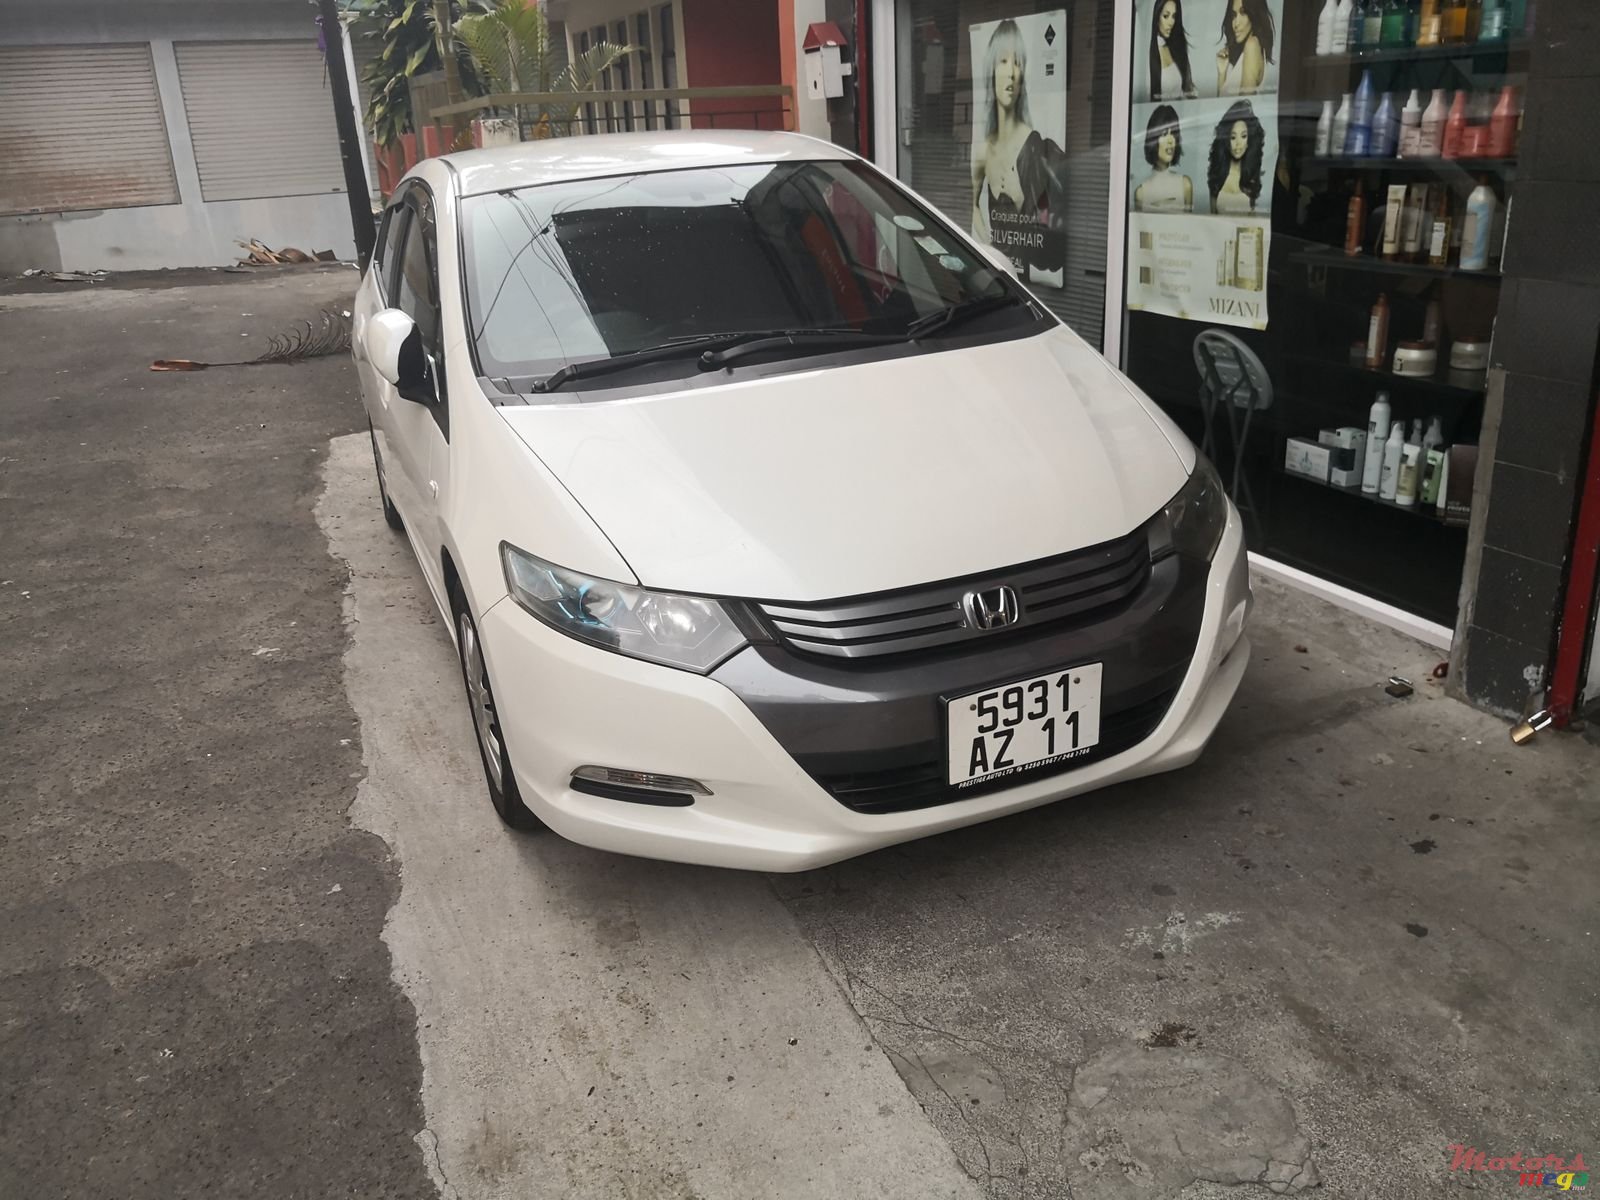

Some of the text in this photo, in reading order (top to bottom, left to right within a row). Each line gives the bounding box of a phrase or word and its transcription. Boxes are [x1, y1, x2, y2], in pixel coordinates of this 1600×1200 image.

[991, 209, 1018, 223] Craquez
[990, 228, 1044, 249] SILVERHAIR
[1208, 297, 1260, 319] MIZANI
[977, 673, 1070, 734] 5931
[968, 710, 1079, 777] AZ 11
[958, 776, 987, 789] PRESTIGE
